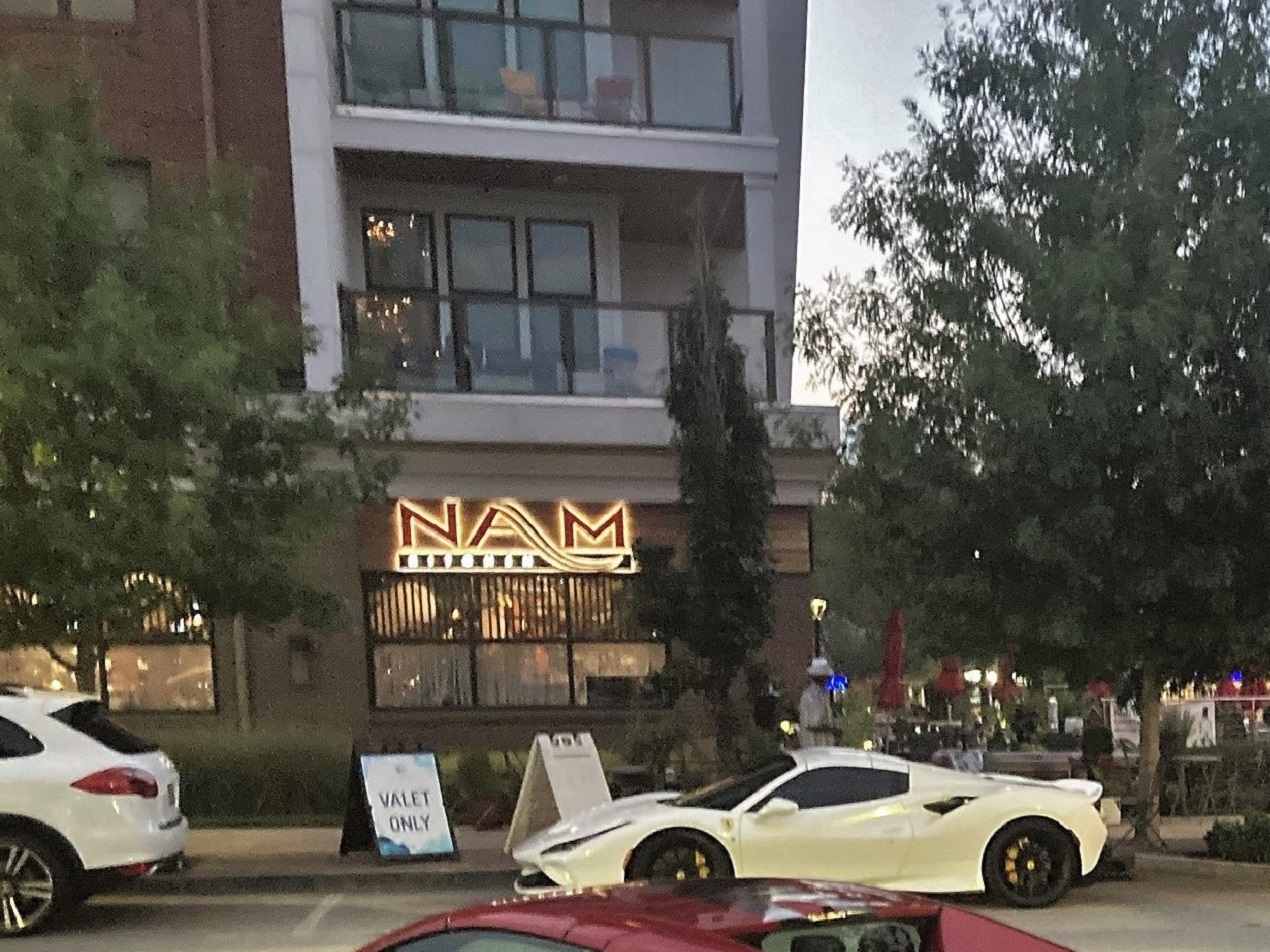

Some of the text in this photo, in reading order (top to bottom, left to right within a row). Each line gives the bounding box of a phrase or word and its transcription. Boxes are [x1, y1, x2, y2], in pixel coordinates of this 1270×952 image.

[398, 498, 629, 562] NAM
[378, 789, 430, 808] VALET
[389, 815, 430, 833] ONLY
